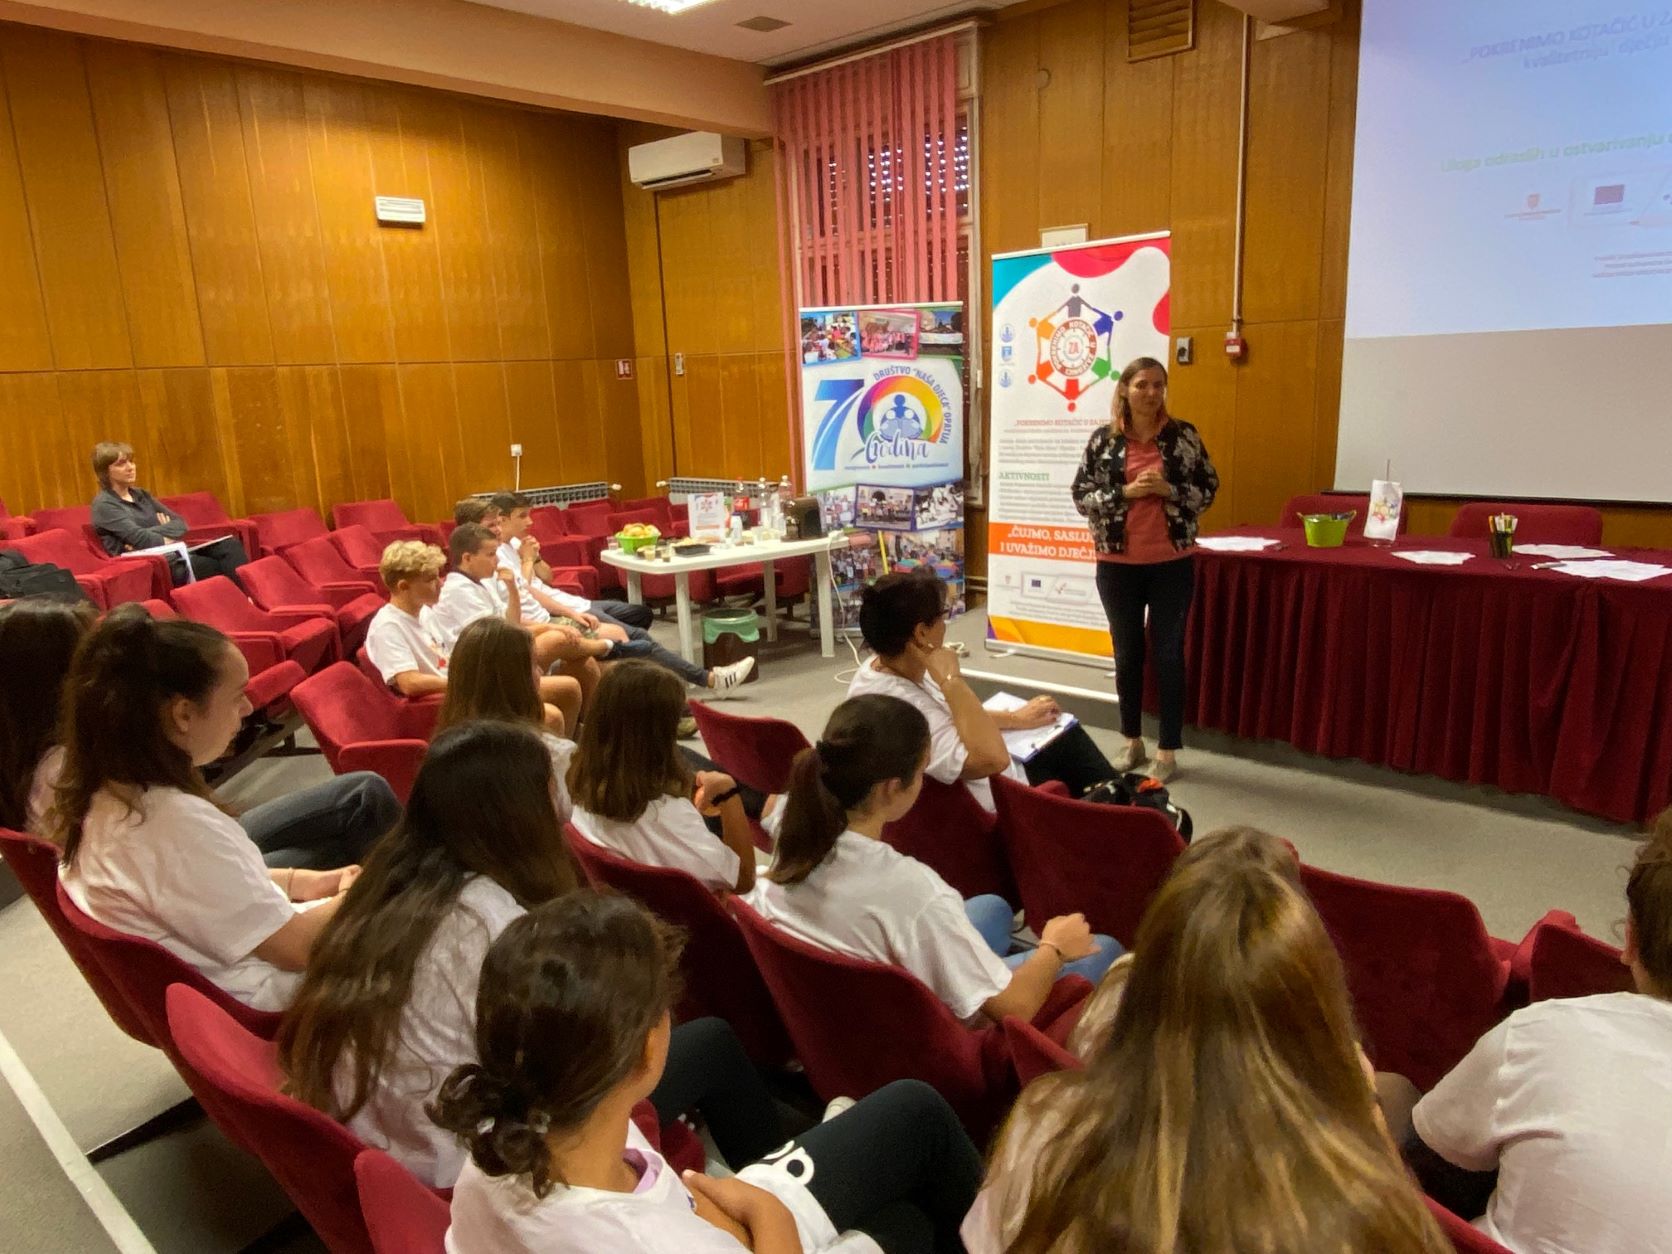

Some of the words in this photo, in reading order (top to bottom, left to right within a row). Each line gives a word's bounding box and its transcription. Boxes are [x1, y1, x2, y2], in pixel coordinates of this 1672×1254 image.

[873, 365, 911, 381] DRUŠTVO
[998, 471, 1050, 482] AKTIVNOSTI
[1006, 542, 1057, 556] UVAŽIMO
